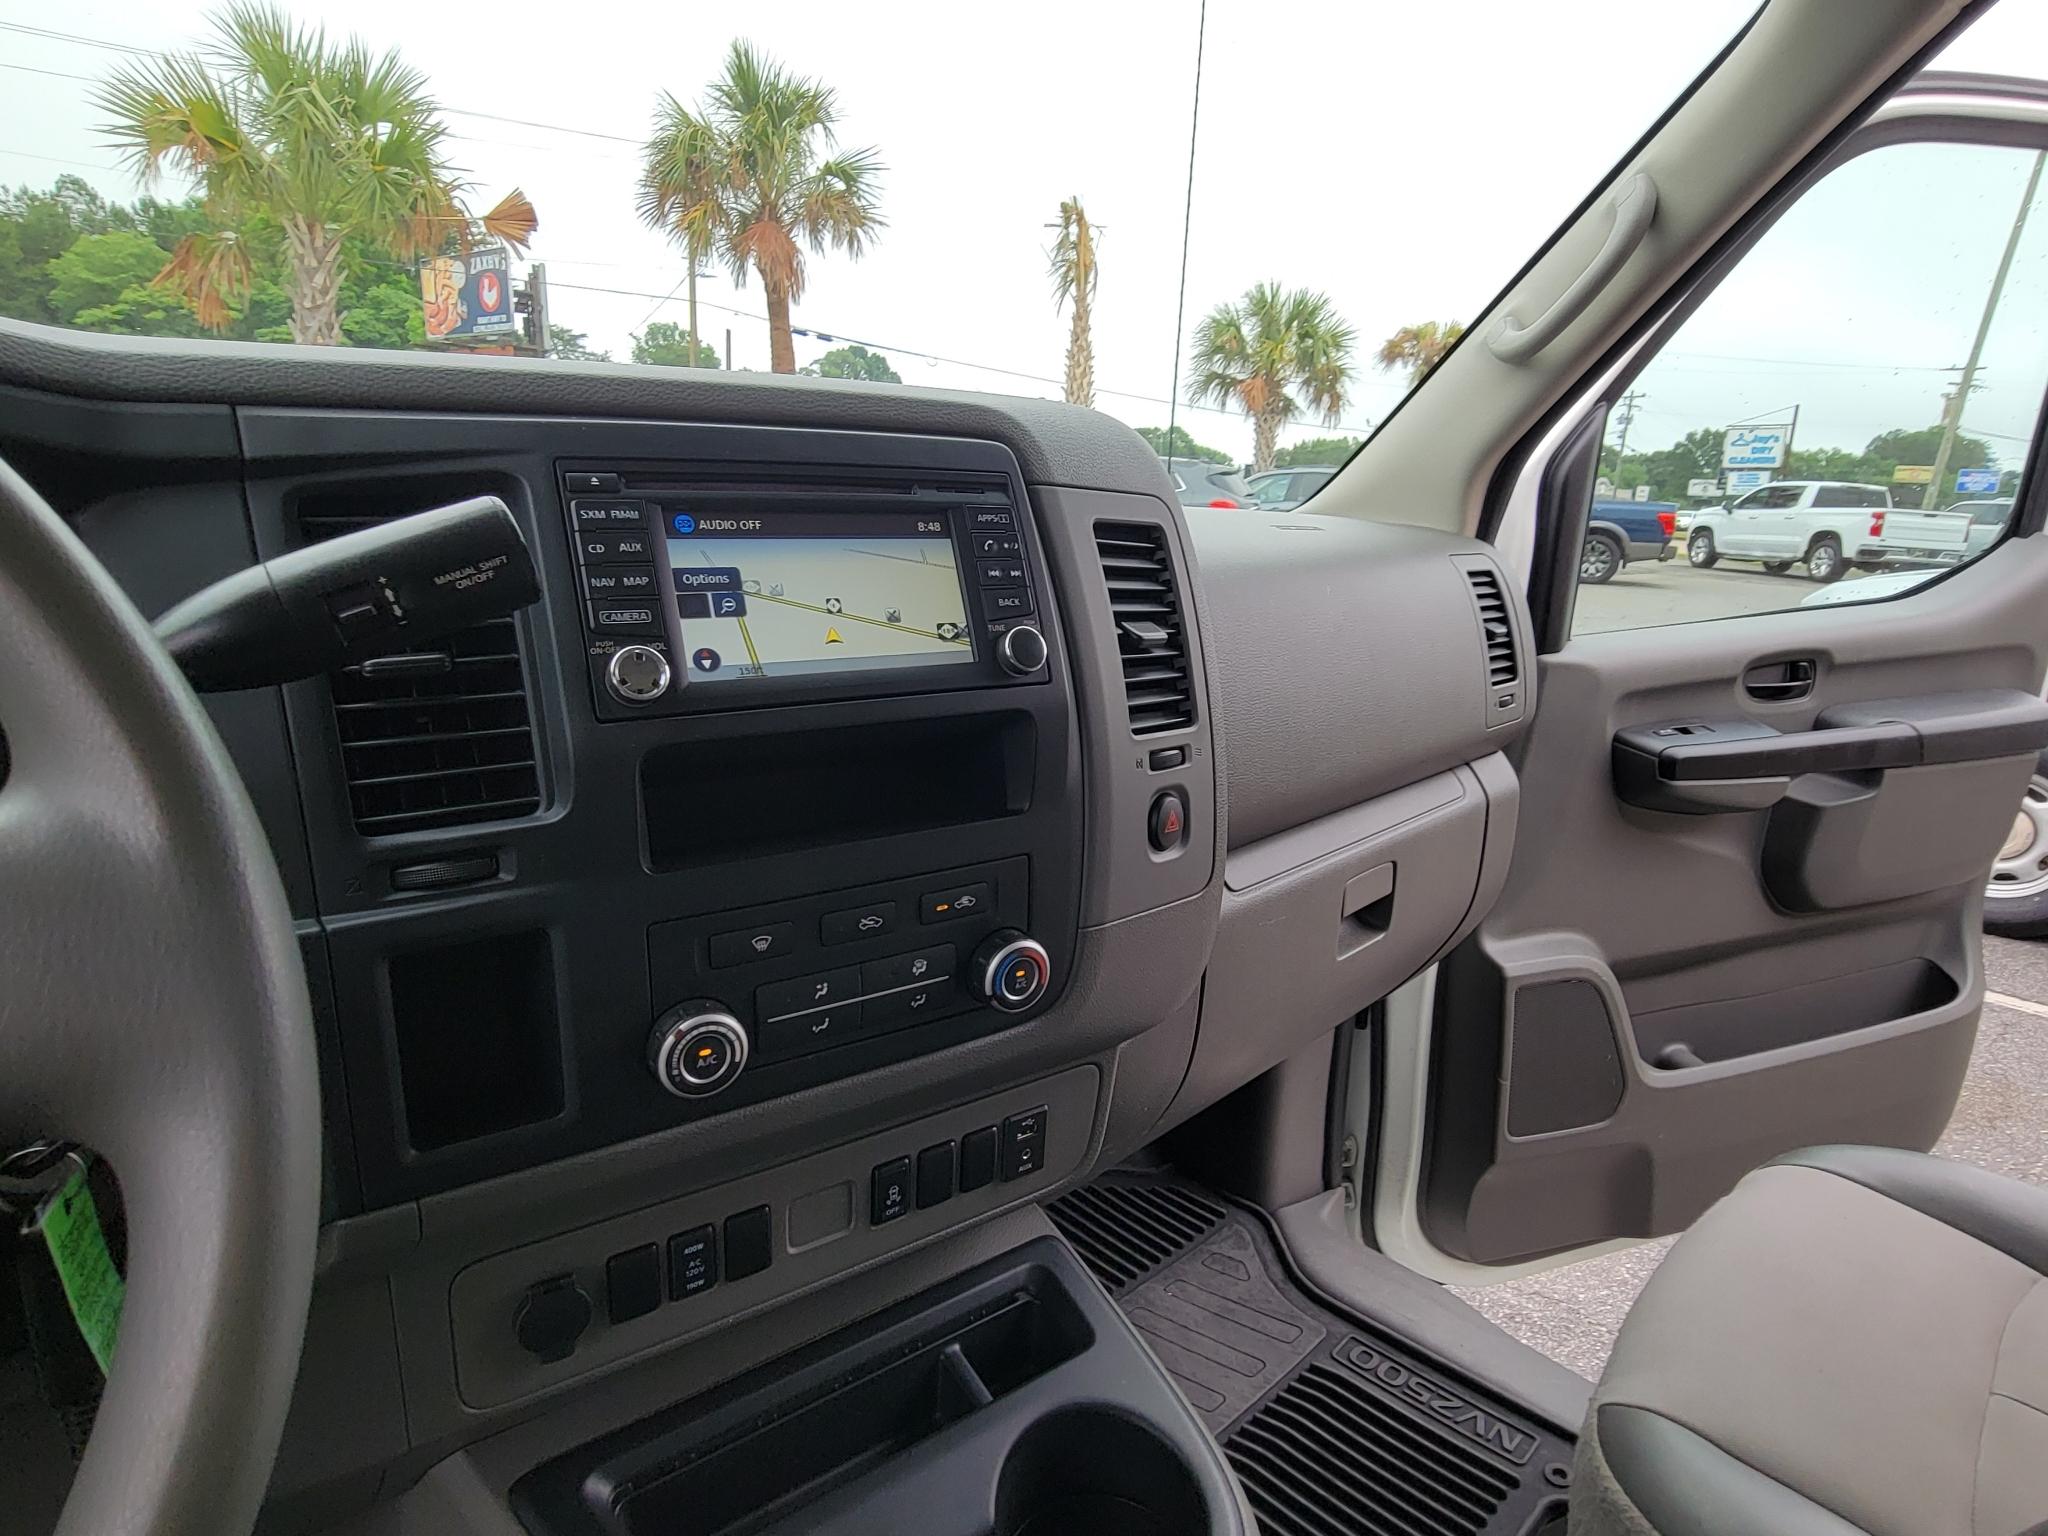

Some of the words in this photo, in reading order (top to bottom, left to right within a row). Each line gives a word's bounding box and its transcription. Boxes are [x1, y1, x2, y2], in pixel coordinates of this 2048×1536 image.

[580, 510, 606, 519] SXM
[699, 520, 737, 530] AUDIO
[740, 520, 762, 530] OFF
[917, 521, 941, 531] 8:48
[588, 544, 605, 553] CD
[619, 543, 642, 552] AUX
[433, 566, 478, 585] MANUAL
[479, 555, 507, 571] SHIFT
[455, 570, 495, 589] ON/OFF
[591, 578, 616, 587] NAV
[623, 577, 650, 586] MAP
[682, 573, 730, 587] Options
[998, 598, 1020, 607] BACK
[602, 612, 648, 622] CAMERA
[988, 624, 1006, 632] TUNE
[696, 1054, 717, 1069] A/C
[886, 1206, 900, 1216] OFF
[1348, 1344, 1527, 1453] NV2500
